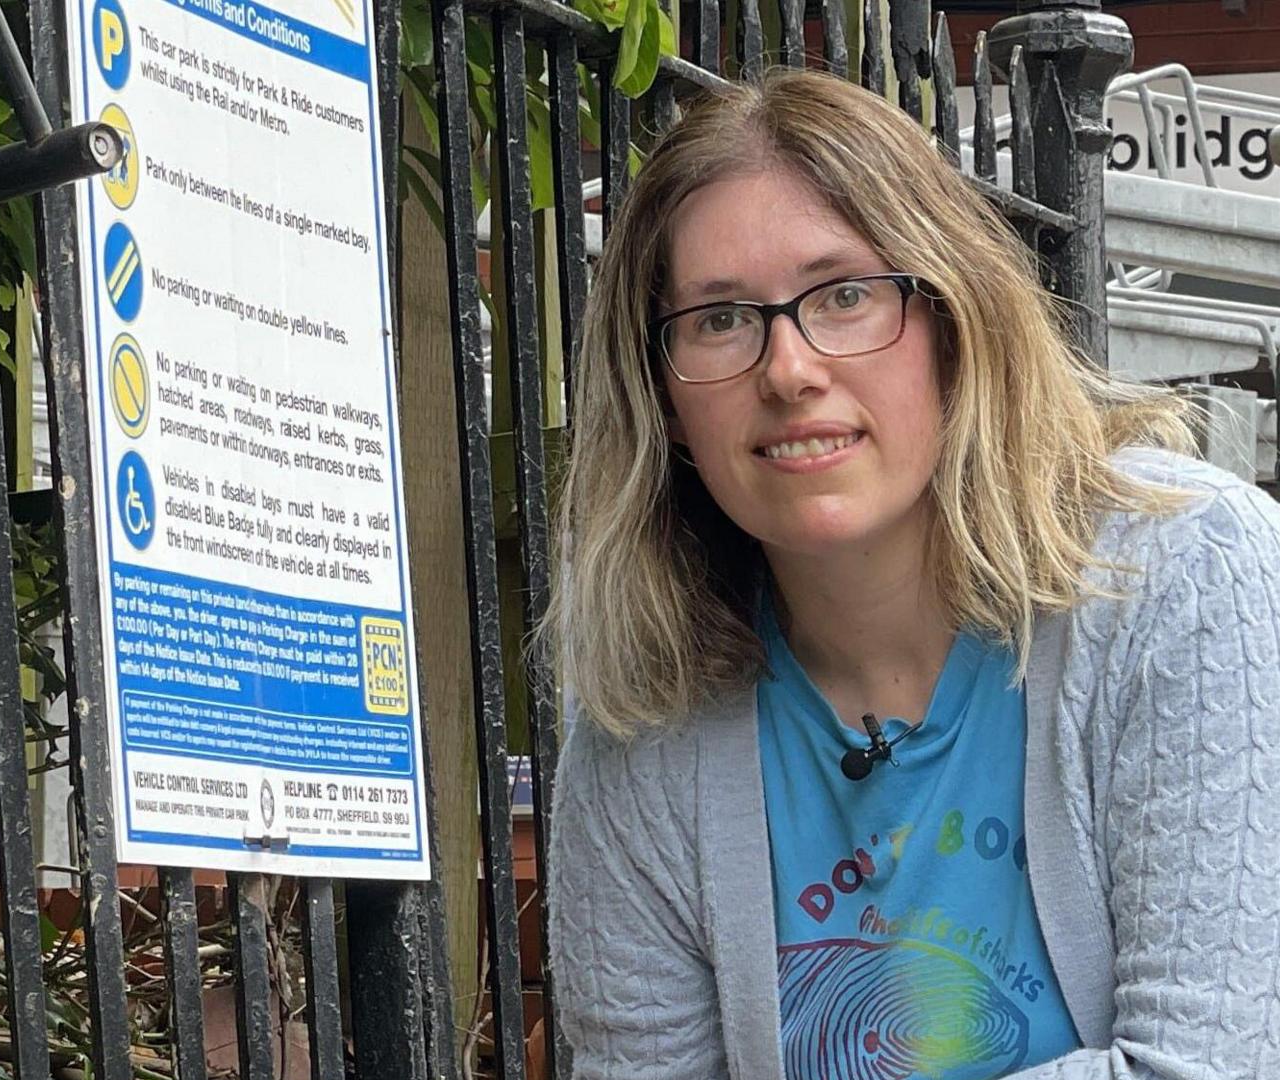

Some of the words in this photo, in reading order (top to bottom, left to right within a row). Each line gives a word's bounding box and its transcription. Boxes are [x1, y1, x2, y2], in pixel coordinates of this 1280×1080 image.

[224, 3, 246, 28] and
[247, 6, 312, 54] Conditions
[138, 25, 159, 53] This
[161, 40, 177, 60] car
[178, 47, 200, 70] park
[201, 52, 210, 75] is
[211, 60, 240, 91] strictly
[241, 70, 255, 93] for
[256, 76, 279, 103] Park
[280, 86, 289, 106] &
[290, 89, 313, 115] Ride
[314, 103, 365, 133] customers
[140, 60, 169, 87] whilst
[169, 73, 195, 103] using
[195, 80, 211, 104] the
[212, 86, 229, 111] Rail
[229, 99, 259, 123] and/or
[259, 106, 290, 135] Metro.
[145, 155, 168, 182] Park
[168, 168, 188, 195] only
[188, 172, 229, 204] between
[229, 188, 242, 211] the
[242, 193, 264, 219] lines
[264, 203, 274, 222] of
[275, 209, 282, 225] a
[283, 209, 313, 236] single
[313, 221, 350, 245] marked
[351, 228, 371, 254] bay.
[151, 267, 166, 290] No
[166, 277, 201, 307] parking
[201, 288, 212, 305] or
[213, 291, 245, 321] waiting
[245, 303, 257, 320] on
[257, 304, 289, 331] double
[289, 315, 322, 338] yellow
[323, 320, 349, 345] lines.
[155, 350, 170, 374] No
[174, 360, 208, 389] parking
[211, 372, 223, 389] or
[226, 375, 257, 402] waiting
[259, 386, 272, 404] on
[275, 390, 328, 416] pedestrian
[331, 402, 383, 431] walkways,
[157, 380, 194, 411] hatched
[199, 398, 228, 423] areas,
[233, 407, 275, 436] roadways,
[279, 417, 311, 441] raised
[317, 424, 349, 451] kerbs,
[354, 436, 385, 458] grass,
[159, 416, 209, 444] pavements
[209, 430, 220, 447] or
[221, 430, 247, 453] within
[248, 437, 291, 468] doorways,
[293, 451, 344, 476] entrances
[345, 462, 356, 478] or
[357, 462, 384, 483] exits.
[161, 464, 200, 493] Vehicles
[204, 475, 215, 497] in
[220, 479, 257, 507] disabled
[260, 489, 282, 516] bays
[287, 501, 315, 519] must
[321, 501, 346, 525] have
[352, 511, 360, 527] a
[366, 511, 390, 532] valid
[164, 495, 202, 524] disabled
[204, 504, 225, 529] Blue
[227, 509, 255, 539] Badge
[255, 517, 274, 544] fully
[275, 524, 293, 544] and
[294, 527, 330, 554] clearly
[332, 532, 380, 560] displayed
[381, 544, 392, 559] in
[165, 526, 182, 549] the
[182, 529, 204, 553] front
[204, 536, 254, 564] windscreen
[254, 547, 264, 566] of
[264, 548, 279, 570] the
[280, 554, 314, 576] vehicle
[315, 559, 327, 578] at
[328, 560, 341, 580] all
[341, 562, 372, 585] times.
[372, 642, 398, 672] PCN
[374, 675, 398, 692] £100
[132, 770, 165, 790] VEHICLE
[166, 773, 200, 794] CONTROL
[200, 777, 234, 798] SERVICES
[234, 781, 248, 799] LTD
[283, 780, 323, 799] HELPLINE
[341, 784, 365, 802] 0114
[367, 786, 383, 803] 261
[385, 787, 409, 805] 7373
[284, 804, 295, 819] PO
[295, 805, 310, 820] BOX
[312, 807, 336, 823] 4777,
[381, 811, 393, 825] S9
[393, 811, 410, 826] 9DJ
[978, 937, 1046, 1003] sharks
